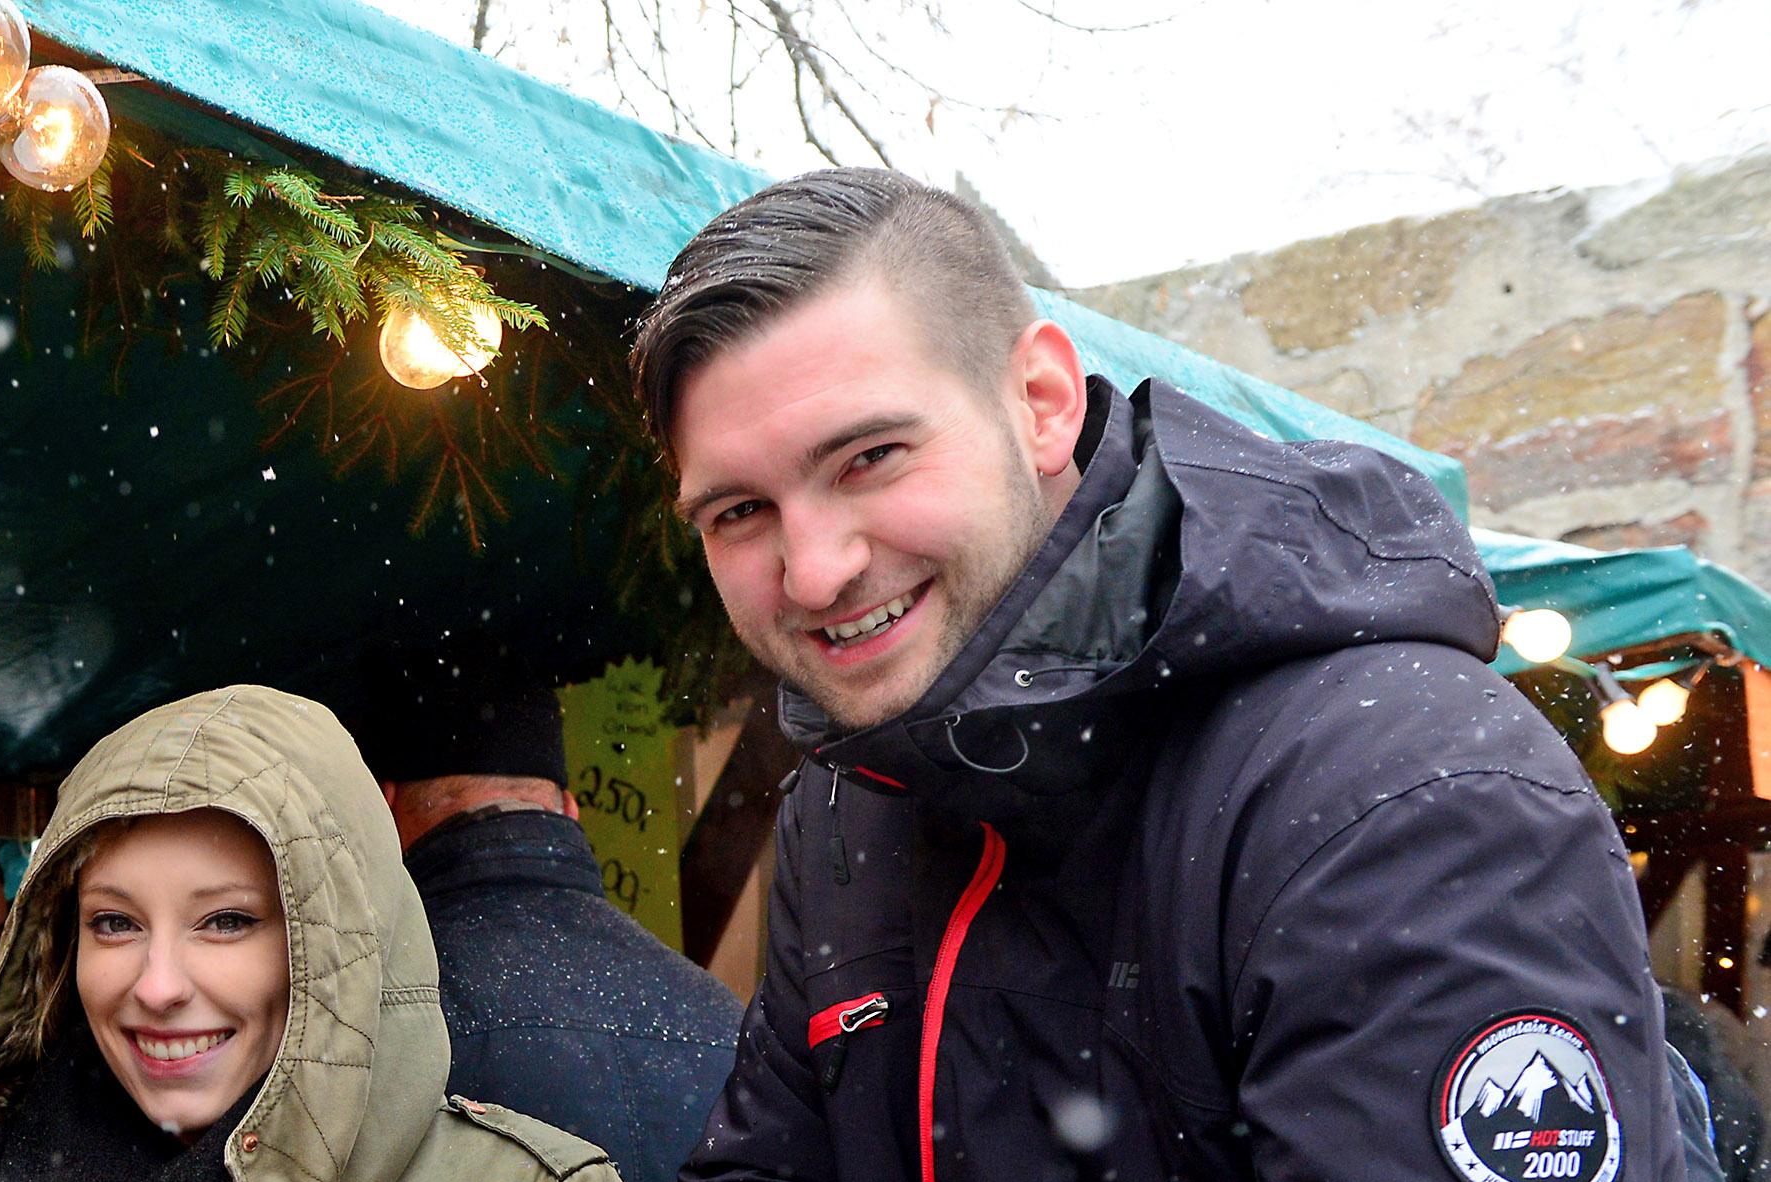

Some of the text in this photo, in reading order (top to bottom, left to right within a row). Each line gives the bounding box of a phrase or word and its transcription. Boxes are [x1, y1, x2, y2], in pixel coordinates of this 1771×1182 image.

[1477, 1018, 1584, 1054] mountain team
[1523, 1150, 1582, 1178] 2000
